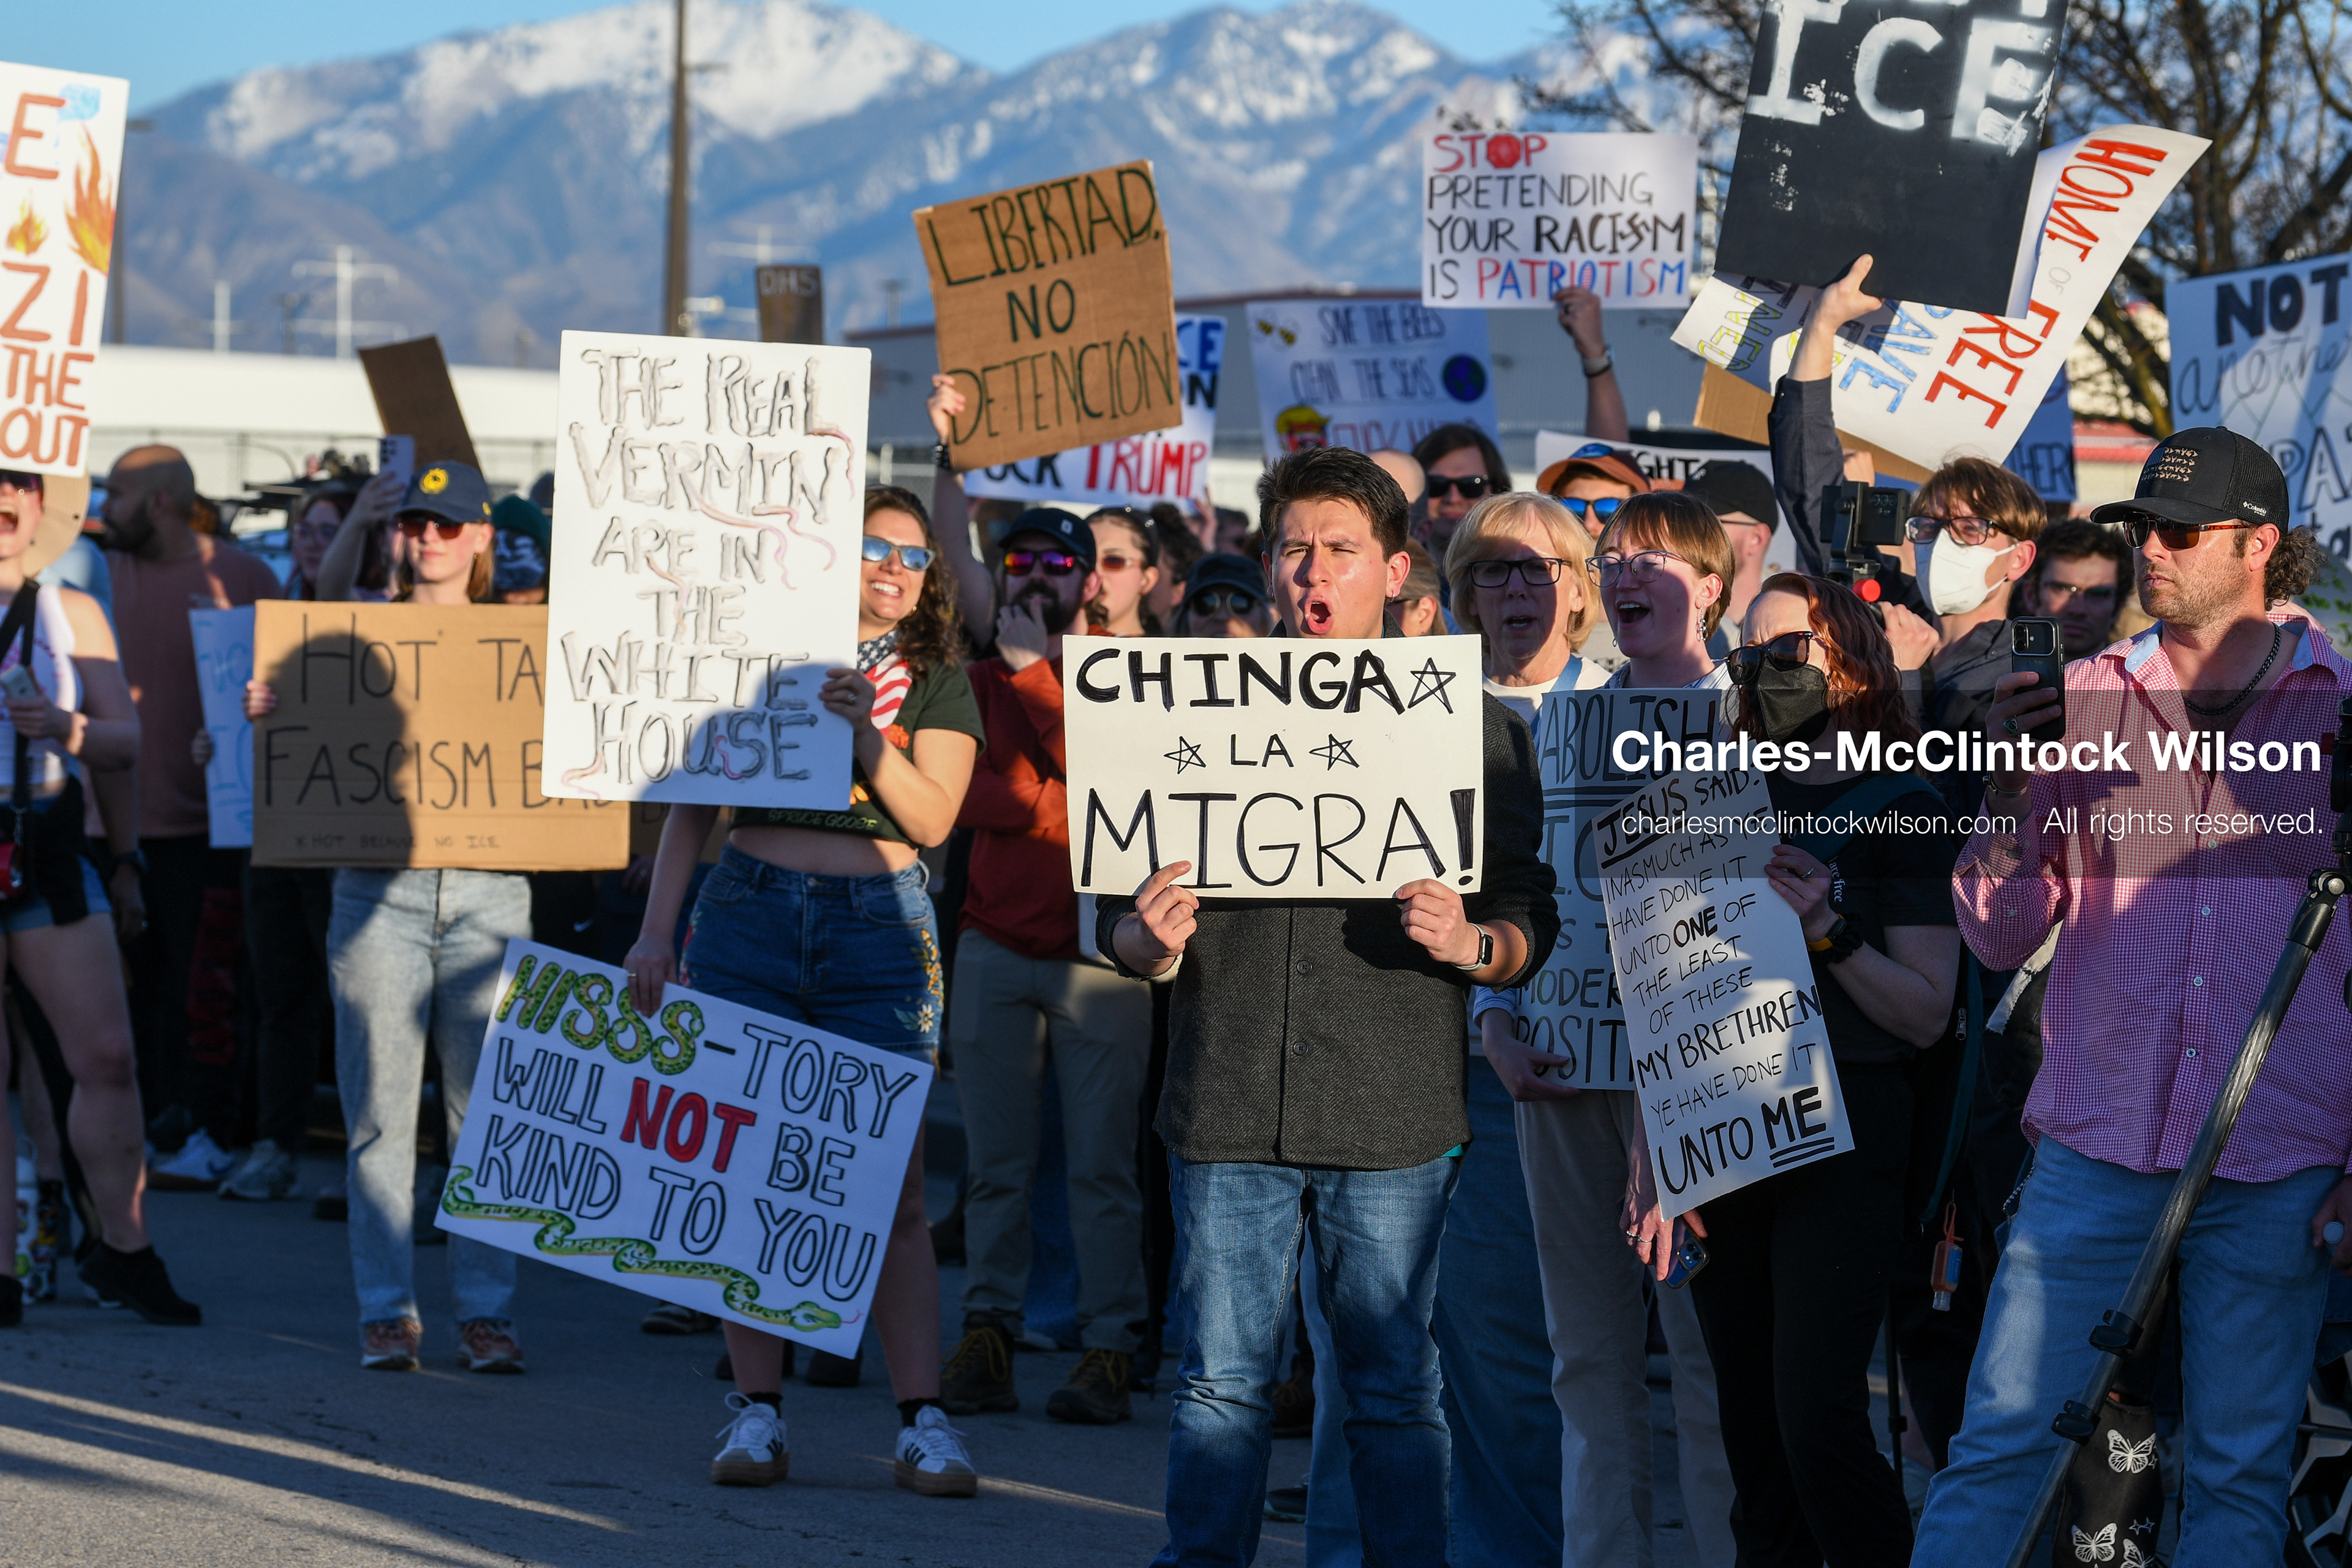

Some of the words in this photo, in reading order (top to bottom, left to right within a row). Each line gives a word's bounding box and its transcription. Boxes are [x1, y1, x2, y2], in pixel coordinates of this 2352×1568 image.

[1744, 0, 2049, 147] ICE
[1428, 172, 1653, 210] PRETENDING
[1433, 133, 1547, 173] STOP
[927, 168, 1159, 286] LIBERTAD,
[1428, 215, 1520, 254] YOUR
[1535, 211, 1685, 254] RACISM
[2048, 140, 2168, 262] HOME
[1006, 278, 1076, 342] NO
[1430, 259, 1460, 300] IS
[1477, 258, 1686, 301] PATRIOTISM
[2216, 262, 2350, 347] NOT
[3, 344, 94, 410] THE
[581, 347, 684, 430] THE
[707, 353, 840, 437] REAL
[947, 331, 1174, 445] DETENCIÓN
[1839, 300, 1954, 413] AVE
[1, 407, 89, 468] OUT
[569, 422, 840, 524] VERMIN
[1085, 439, 1208, 499] TRUMP
[2269, 427, 2352, 512] PA
[593, 516, 696, 576] ARE
[720, 528, 769, 583] IN
[636, 585, 748, 647] THE
[301, 612, 437, 705] HOT
[561, 629, 811, 710] WHITE
[1076, 648, 1406, 715] CHINGA
[265, 726, 497, 809] FASCISM
[593, 699, 820, 785] HOUSE
[1230, 733, 1295, 768] LA
[1540, 694, 1716, 785] ABOLISH
[825, 813, 878, 831] GOOSE
[1080, 788, 1476, 889] MIGRA!
[1597, 778, 1687, 856] JESUS
[1605, 835, 1695, 905] INASMUCH
[1700, 824, 1729, 854] AS
[1611, 897, 1656, 941] HAVE
[1659, 868, 1714, 913] DONE
[1722, 856, 1747, 885] IT
[1620, 933, 1671, 975] UNTO
[1673, 905, 1718, 948] ONE
[1724, 893, 1757, 923] OF
[1633, 967, 1672, 1007] THE
[1678, 935, 1741, 981] LEAST
[1637, 1043, 1673, 1089] MY
[1676, 985, 1823, 1068] BRETHREN
[1649, 1001, 1674, 1034] OF
[1682, 966, 1753, 1014] THESE
[493, 1038, 607, 1134] WILL
[620, 1077, 756, 1173] NOT
[767, 1122, 856, 1207] BE
[1650, 1098, 1675, 1133] YE
[1676, 1073, 1729, 1118] HAVE
[1732, 1053, 1782, 1091] DONE
[1792, 1042, 1817, 1072] IT
[1658, 1117, 1754, 1195] UNTO
[1760, 1086, 1827, 1150] ME
[477, 1115, 620, 1220] KIND
[649, 1167, 726, 1255] TO
[755, 1199, 876, 1302] YOU
